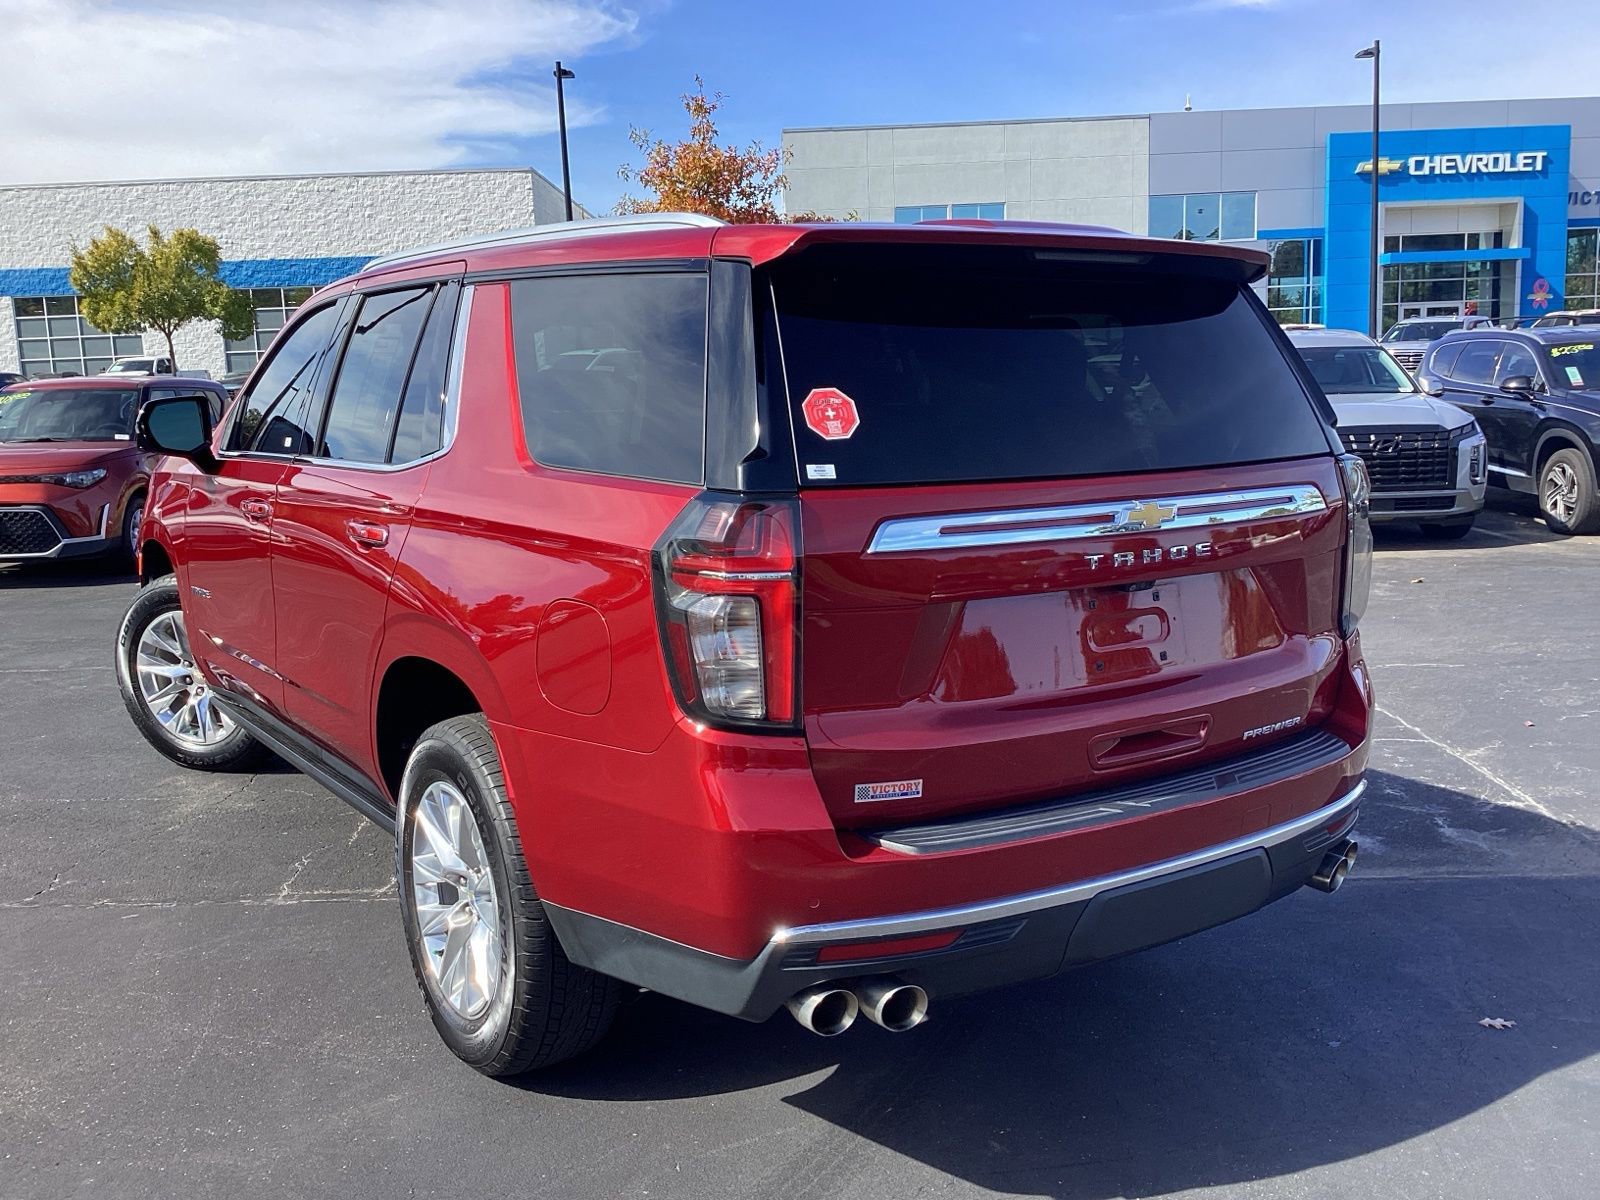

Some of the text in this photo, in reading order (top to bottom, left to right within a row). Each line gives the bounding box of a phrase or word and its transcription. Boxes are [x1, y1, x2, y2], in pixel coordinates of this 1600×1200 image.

[1408, 152, 1547, 175] CHEVROLET
[1084, 542, 1211, 570] TAHOE
[1243, 716, 1301, 740] PREMIER
[871, 782, 920, 794] VICTORY
